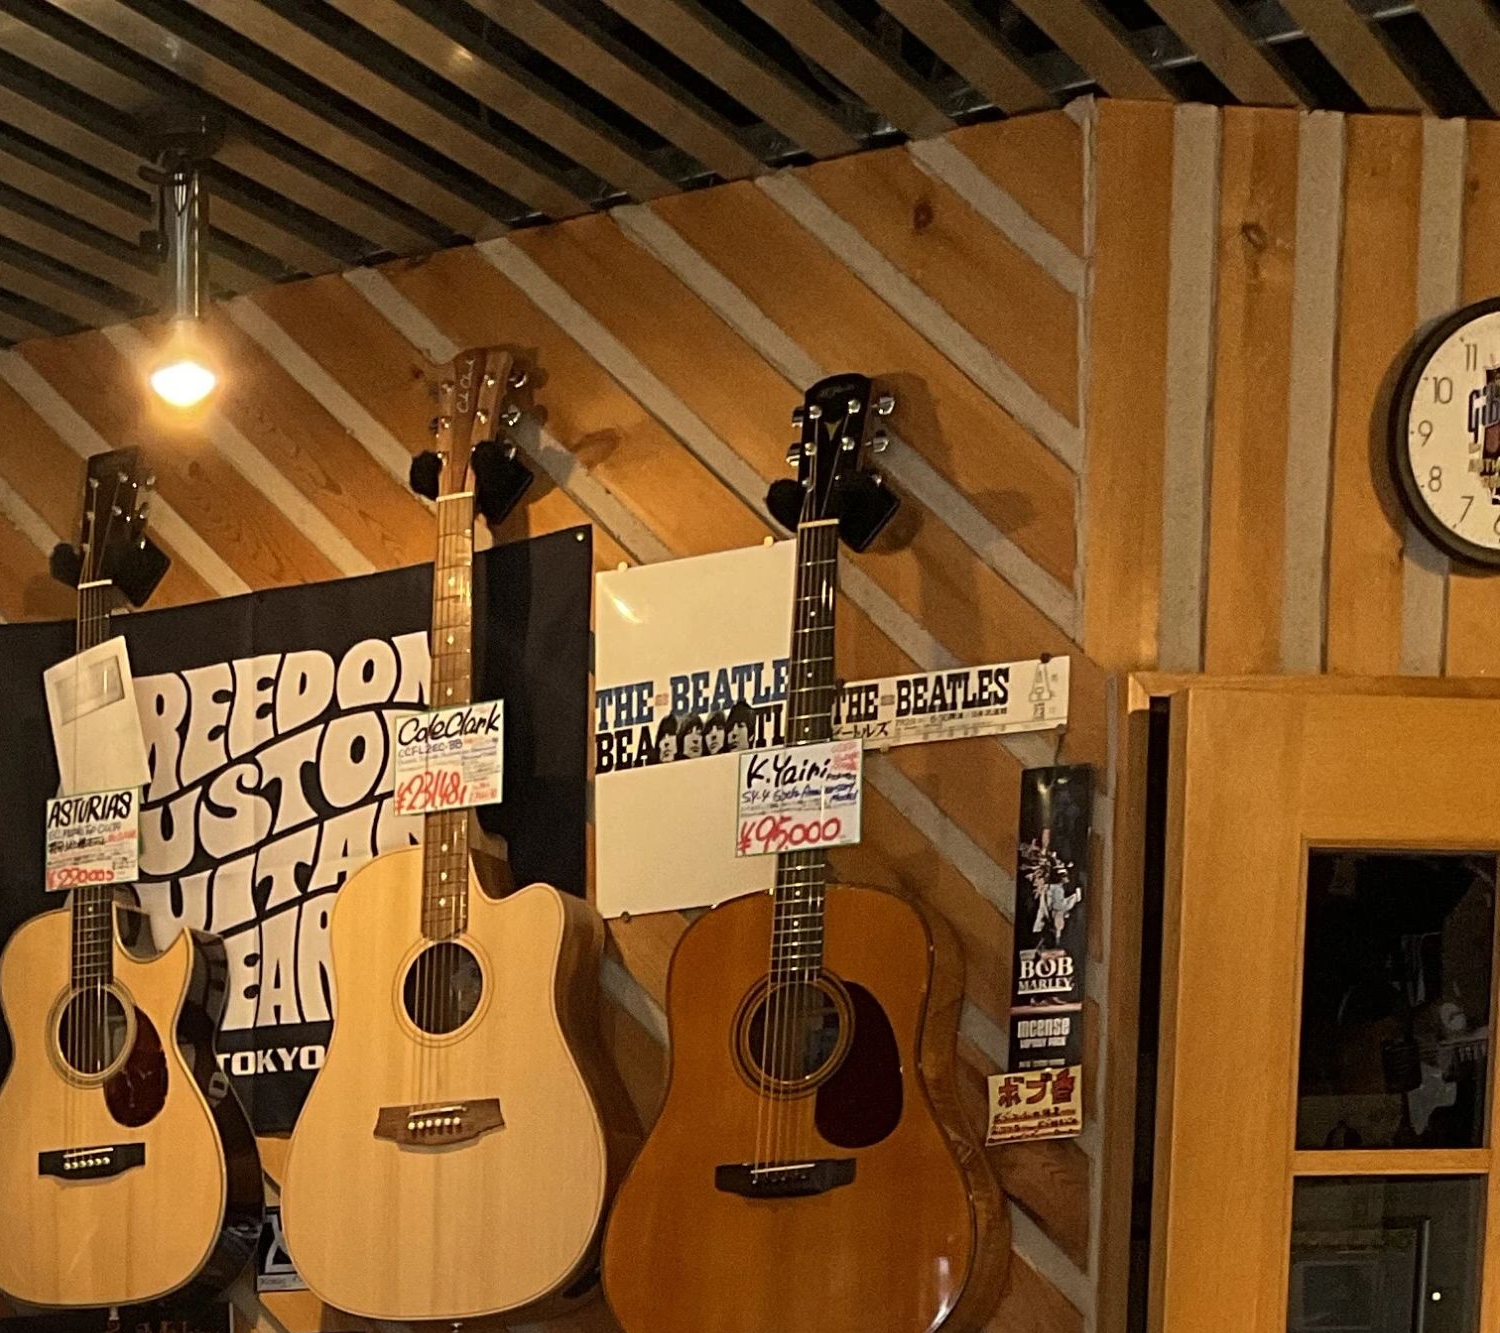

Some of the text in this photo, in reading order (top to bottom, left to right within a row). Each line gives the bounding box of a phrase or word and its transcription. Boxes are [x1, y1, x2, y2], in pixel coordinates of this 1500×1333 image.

[1465, 344, 1477, 371] 11
[1433, 376, 1453, 404] 10
[1418, 420, 1433, 447] 9
[1428, 466, 1442, 492] 8
[1460, 496, 1474, 522] 7
[596, 681, 655, 731] THE
[832, 684, 879, 727] THE
[895, 667, 1009, 717] BEATLES
[48, 791, 133, 829] ASTURIAS
[1019, 956, 1074, 980] BOB
[1018, 976, 1074, 993] MARLEY
